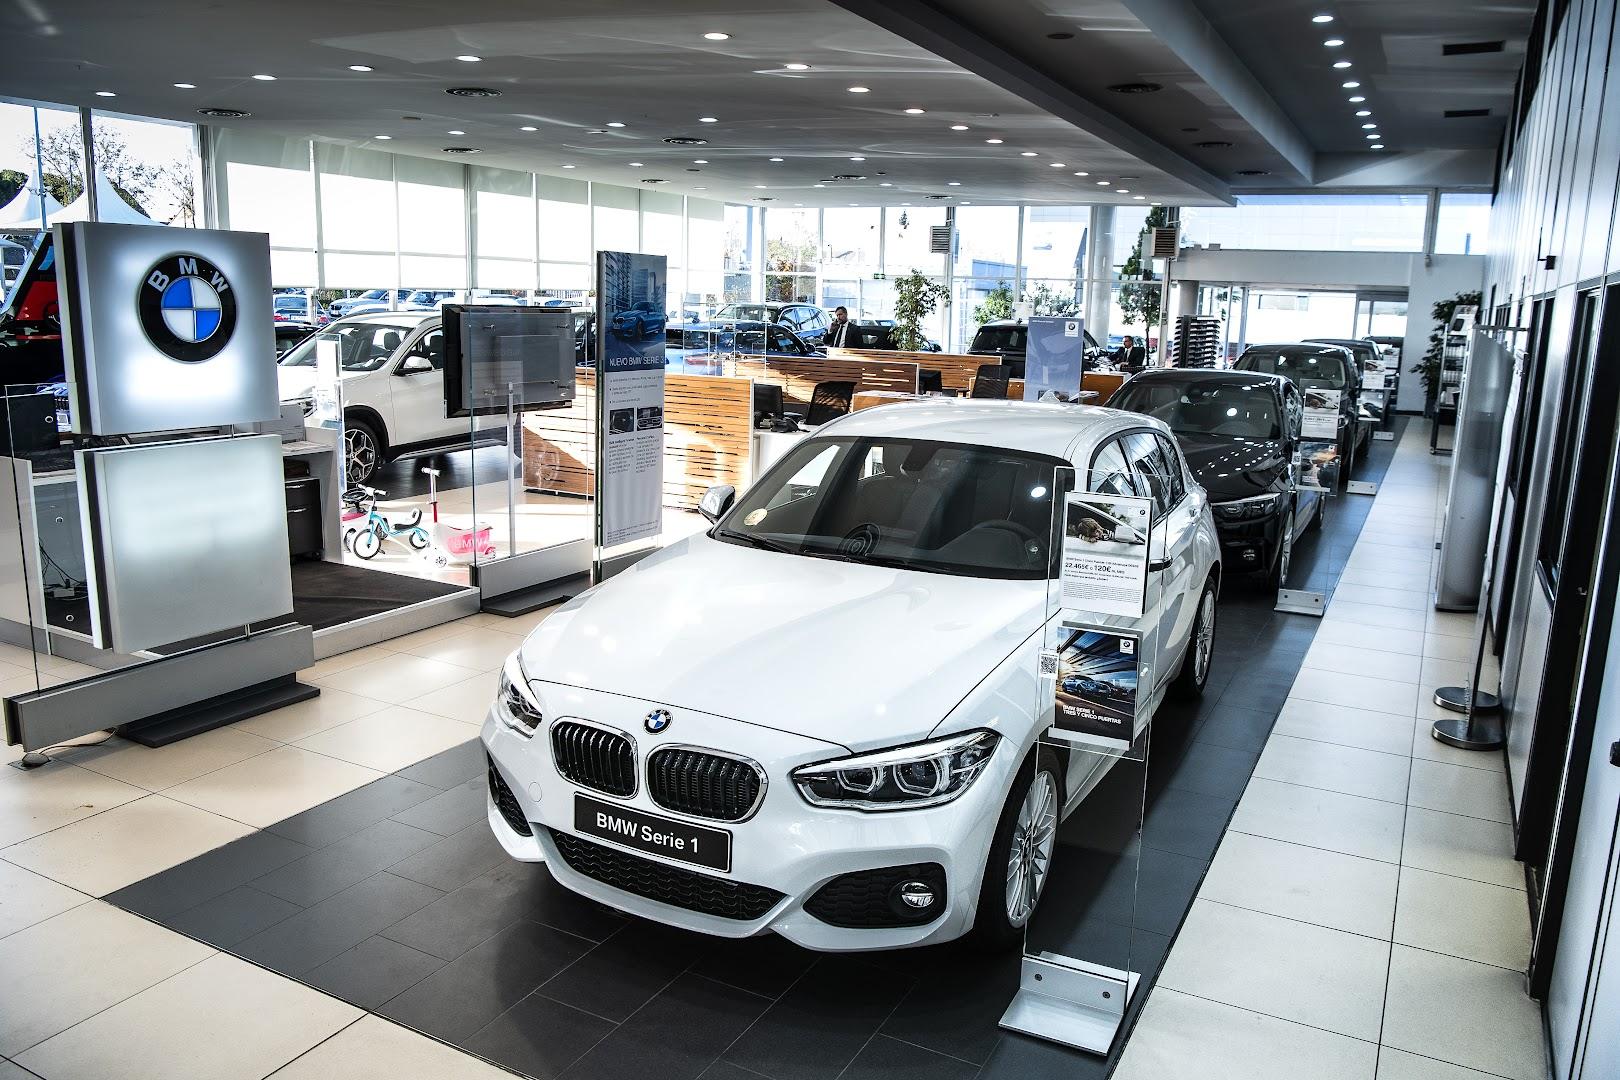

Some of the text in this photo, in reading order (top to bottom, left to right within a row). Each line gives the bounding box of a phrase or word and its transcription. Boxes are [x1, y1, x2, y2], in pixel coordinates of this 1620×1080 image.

[147, 257, 230, 293] BMW
[609, 357, 628, 367] NUEVO
[629, 357, 642, 366] BMW
[643, 355, 660, 365] SERIE
[1081, 712, 1097, 720] CINCO
[1098, 716, 1122, 724] PUERTAS
[596, 812, 698, 854] BMW Serie 1
